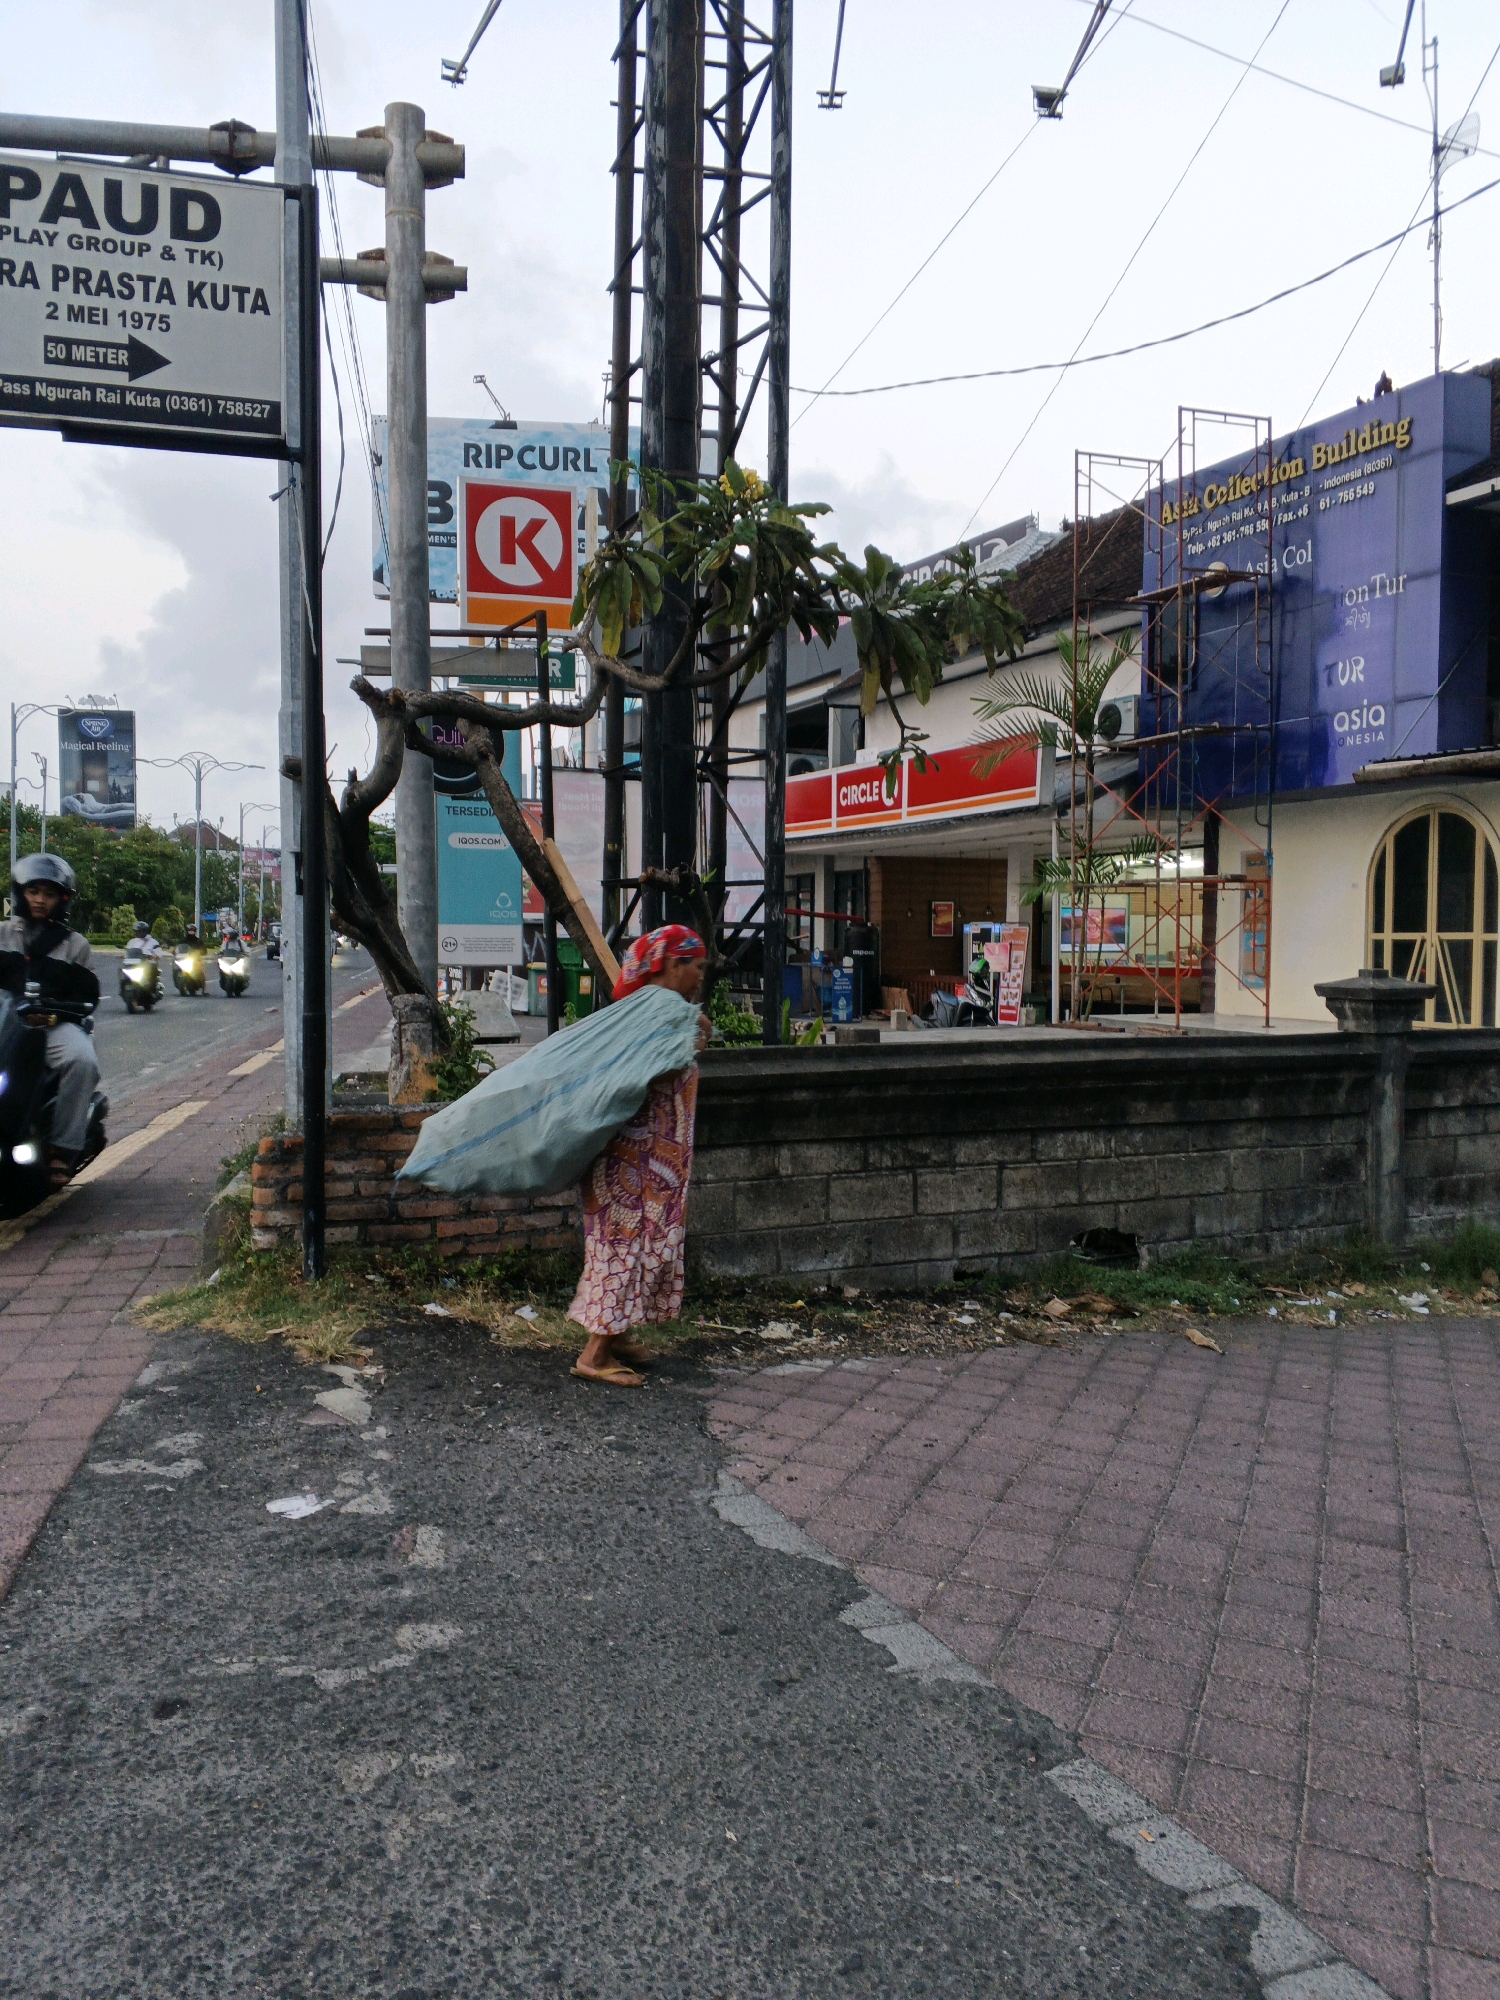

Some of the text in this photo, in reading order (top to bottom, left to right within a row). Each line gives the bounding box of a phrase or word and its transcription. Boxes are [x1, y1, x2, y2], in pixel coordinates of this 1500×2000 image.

[0, 164, 222, 243] PAUD
[0, 224, 223, 271] PLAY GROUP & TK)
[52, 264, 176, 306] PRASTA
[187, 280, 271, 316] KUTA
[45, 302, 171, 333] 2 MEI 1975
[47, 343, 129, 366] 50 METER
[0, 380, 271, 418] ass Ngurah Rai Kuta (0361) 758527
[1162, 416, 1413, 526] Asia Collection Building
[1282, 491, 1298, 504] Kuta
[1324, 467, 1362, 490] Indonesia
[1364, 453, 1393, 475] (80361)
[1278, 511, 1296, 525] Fax.
[1338, 488, 1355, 504] 766
[1356, 481, 1375, 498] 549
[1334, 699, 1385, 733] asia
[60, 741, 94, 751] Magical
[840, 781, 880, 806] CIRCLE
[458, 837, 501, 846] IQOS.COM
[490, 910, 517, 918] IQOS
